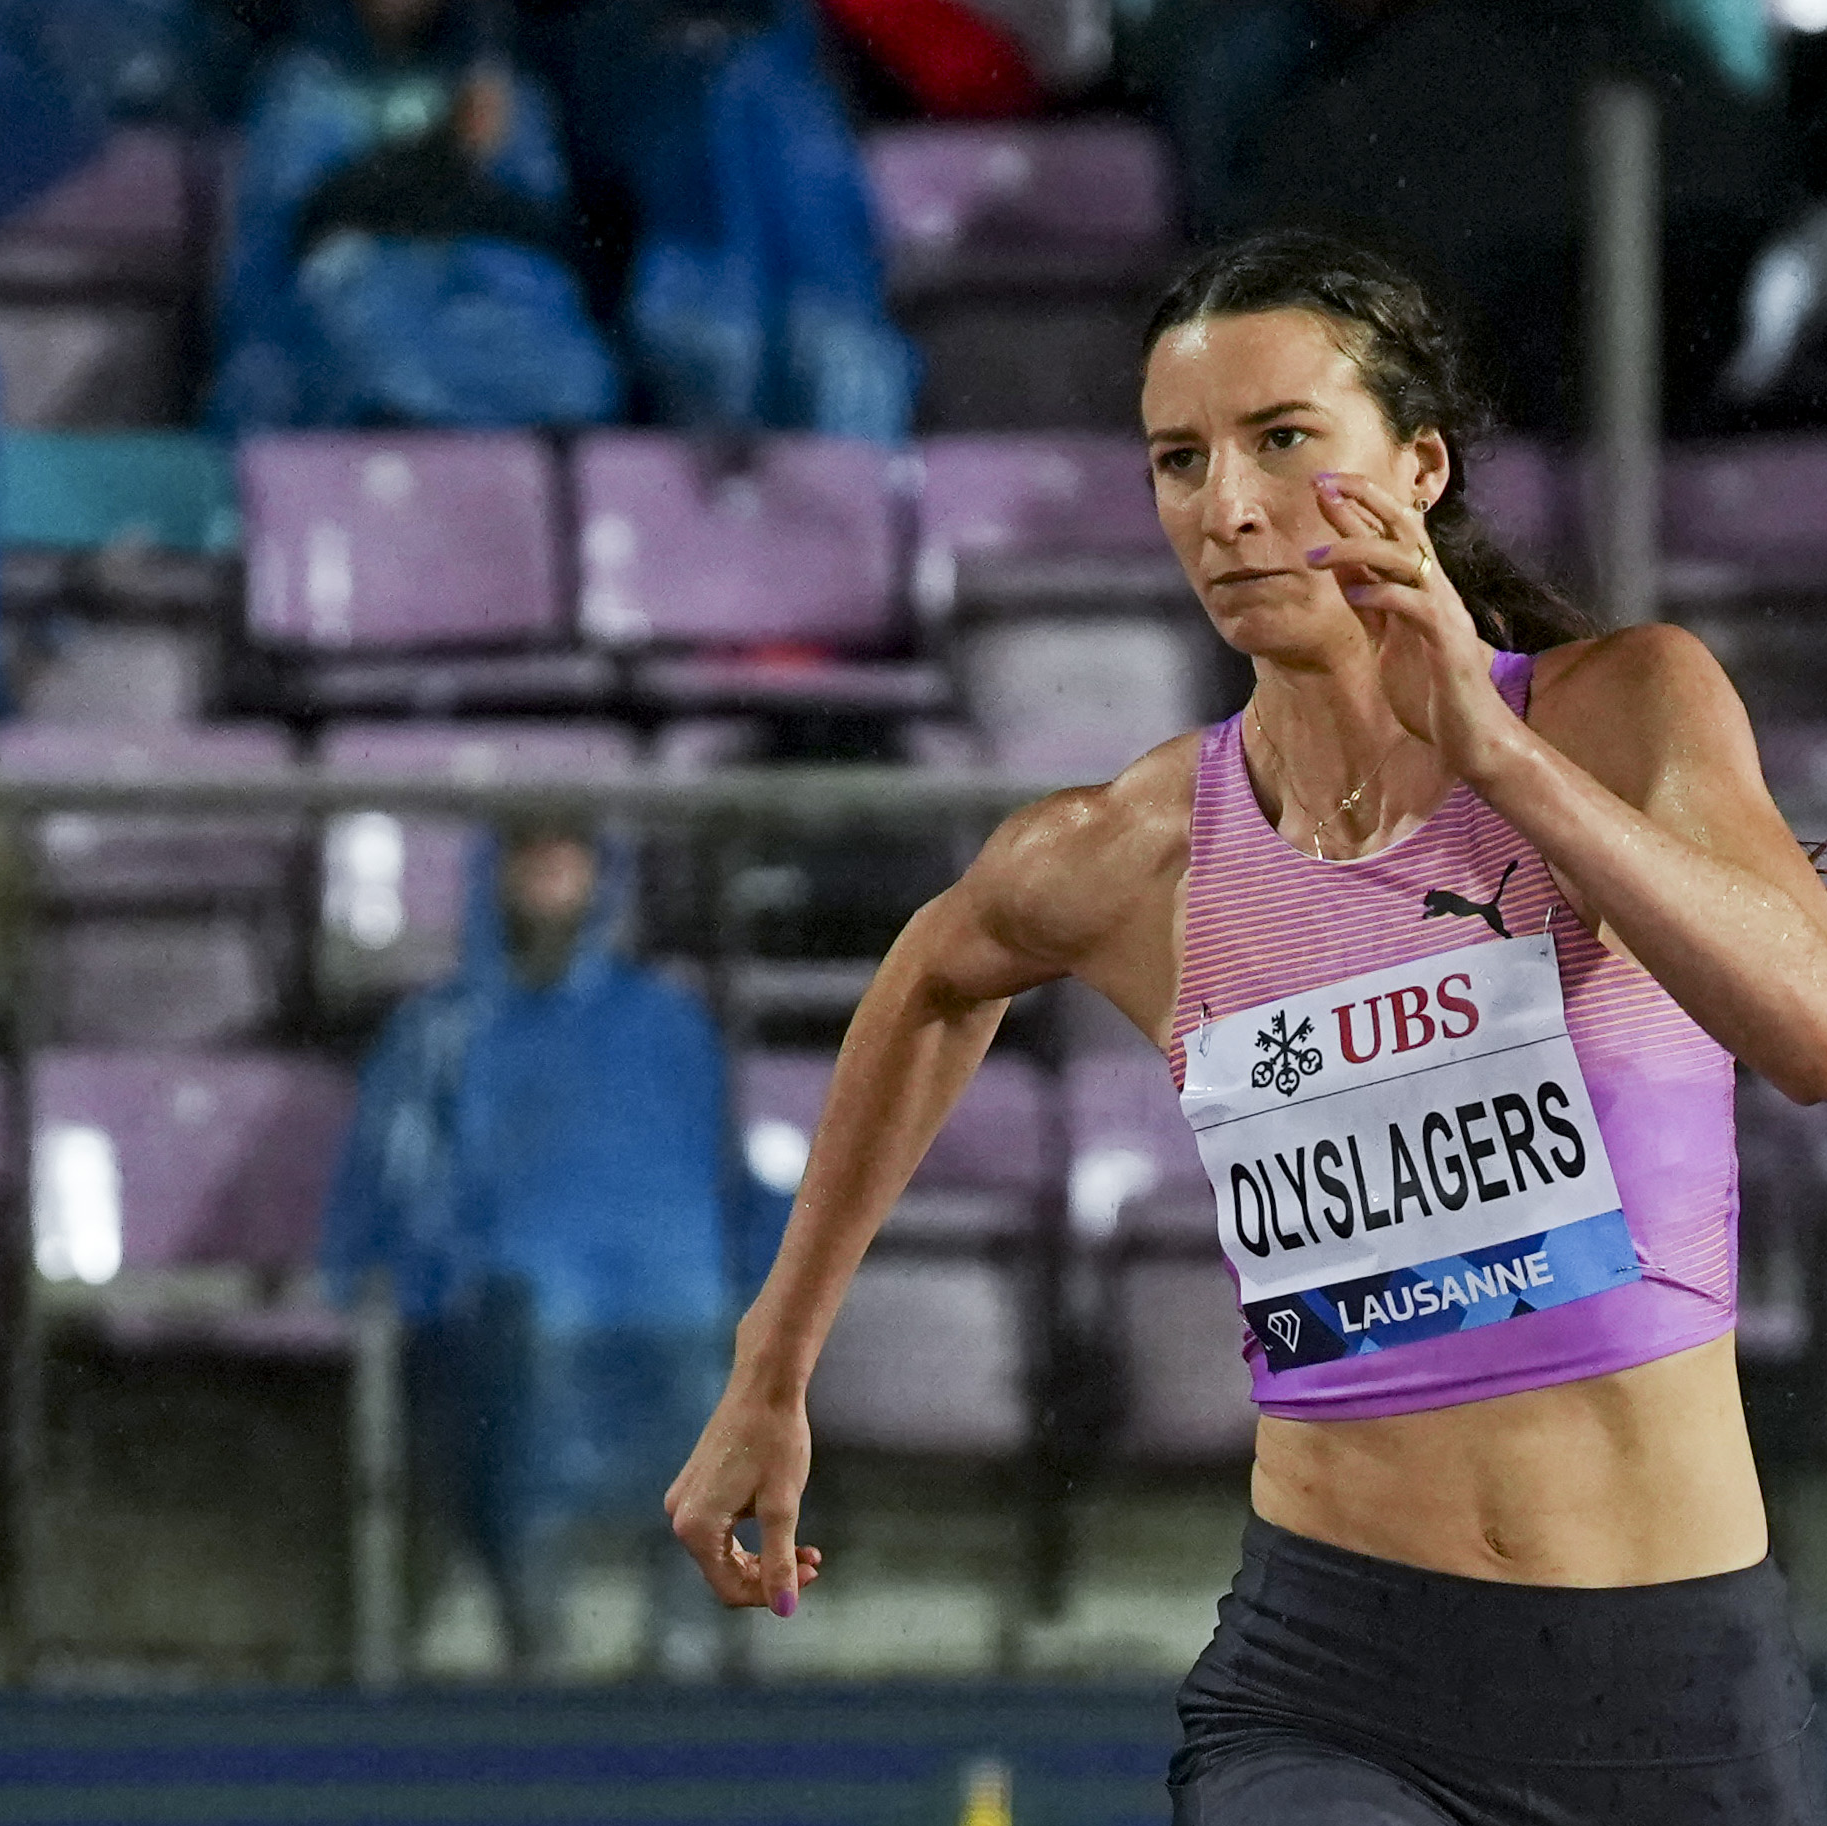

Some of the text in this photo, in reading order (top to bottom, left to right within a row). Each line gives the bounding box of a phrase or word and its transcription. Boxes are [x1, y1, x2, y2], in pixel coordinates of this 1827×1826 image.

[1332, 974, 1480, 1064] UBS
[1229, 1080, 1587, 1258] OLYSLAGERS
[1337, 1251, 1554, 1334] LAUSANNE
